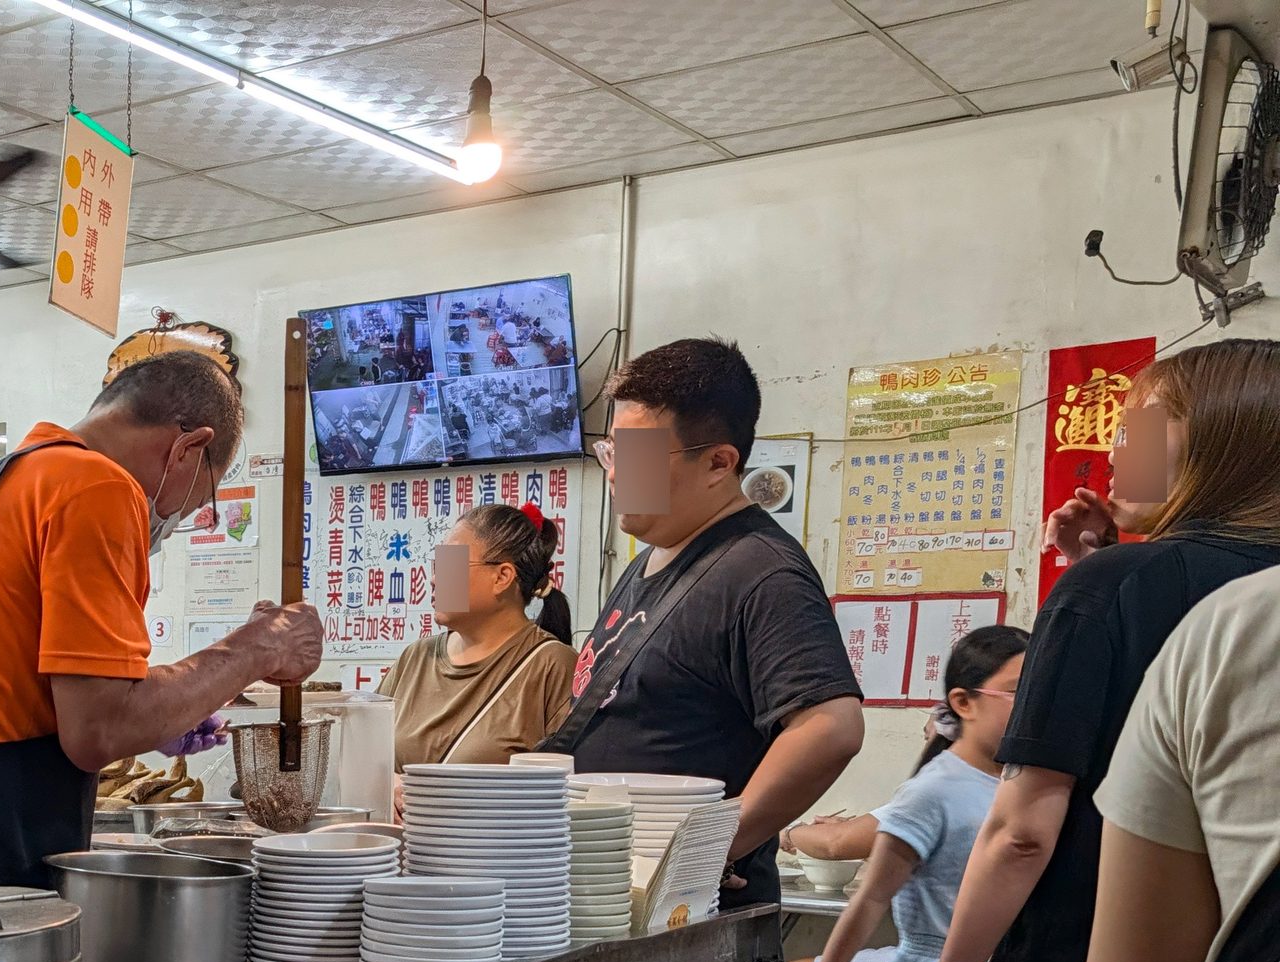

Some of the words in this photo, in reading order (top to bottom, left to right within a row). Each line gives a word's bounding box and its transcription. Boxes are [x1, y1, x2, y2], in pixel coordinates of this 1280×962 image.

[78, 148, 97, 217] 內用
[97, 160, 115, 227] 外帶
[80, 225, 99, 300] 請排隊
[847, 456, 862, 526] 鴨肉飯
[862, 455, 876, 526] 鴨肉冬粉
[875, 454, 890, 525] 鴨肉湯
[890, 453, 905, 524] 綜合下水冬粉
[919, 451, 934, 522] 鴨肉切盤
[327, 486, 345, 607] 燙青菜
[858, 541, 873, 553] 70
[874, 530, 885, 541] 80
[931, 538, 944, 549] 90
[855, 574, 871, 584] 70
[900, 573, 912, 582] 40
[155, 621, 165, 637] 3
[871, 606, 892, 654] 點餐時
[951, 600, 971, 650] 上菜
[849, 629, 866, 685] 請報桌
